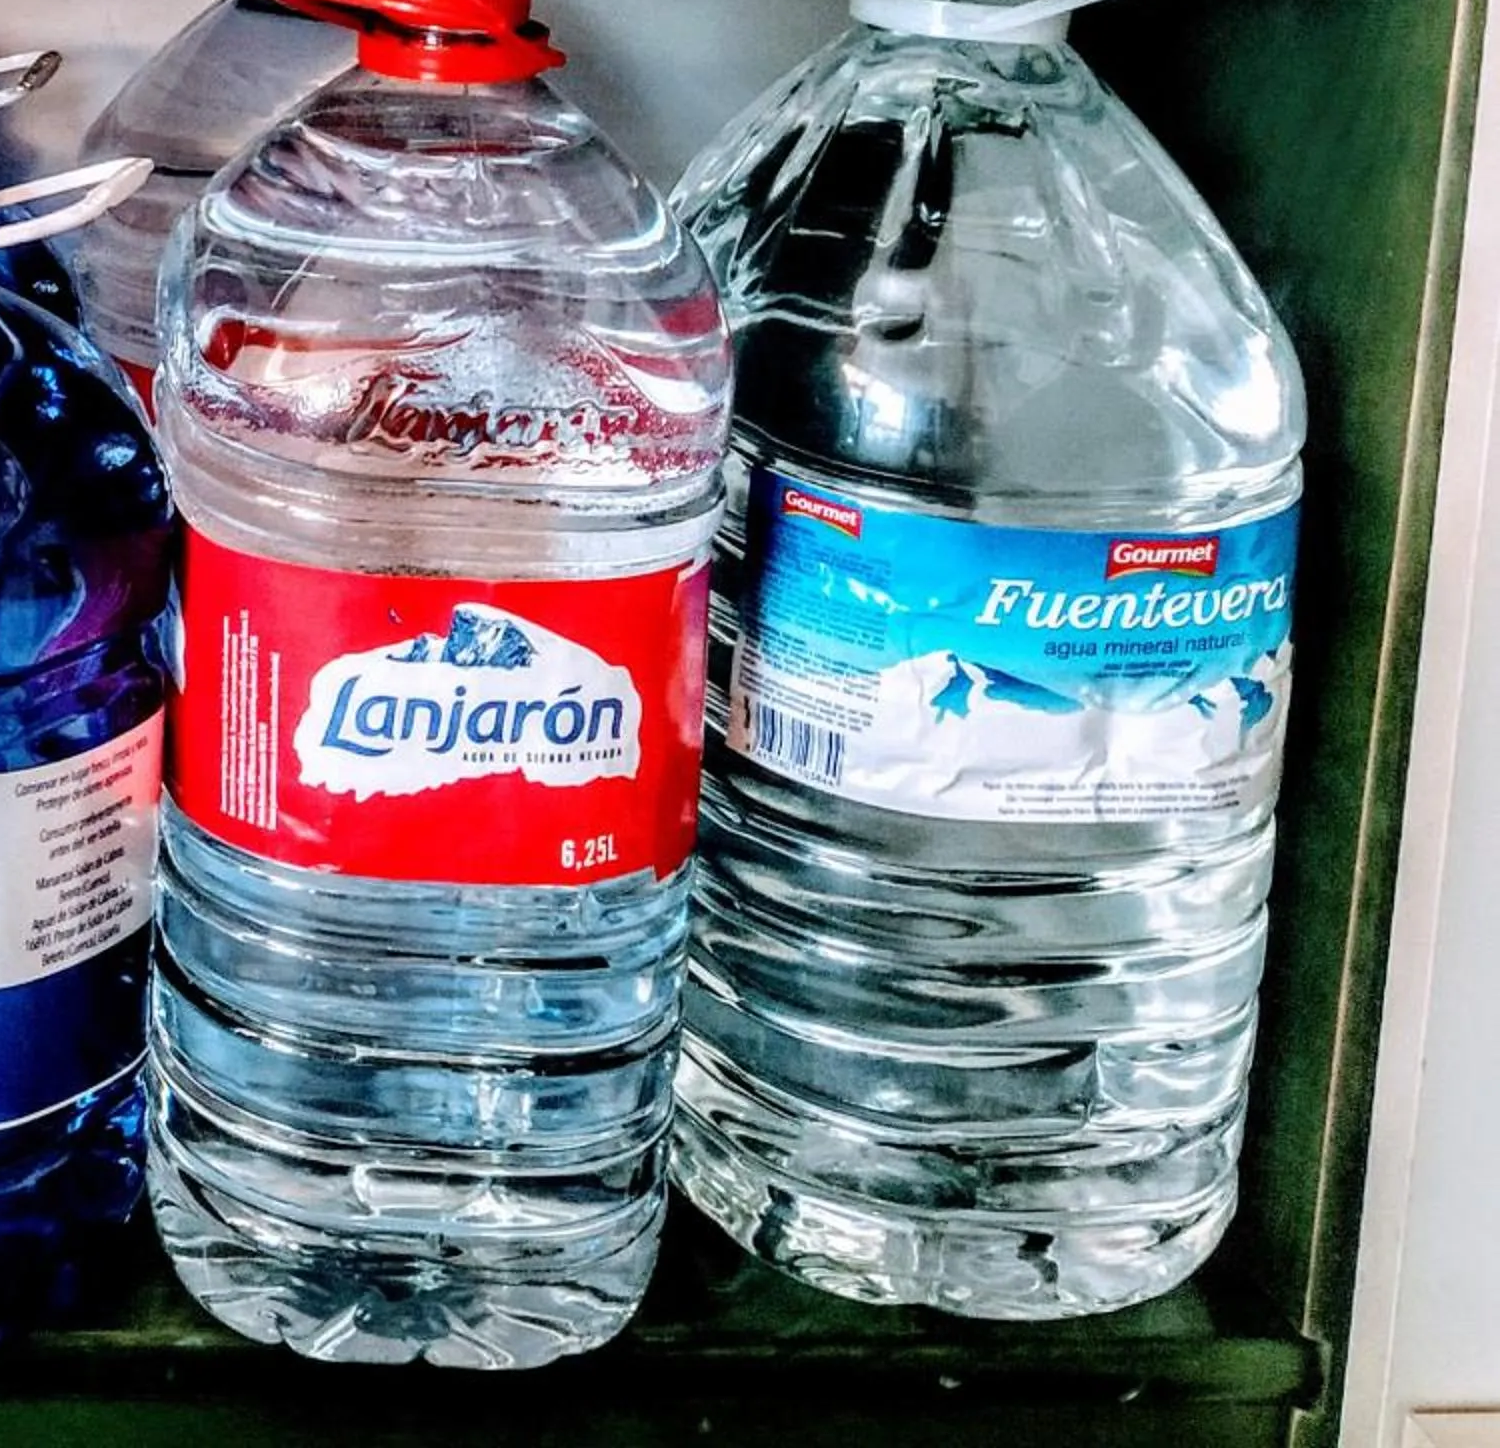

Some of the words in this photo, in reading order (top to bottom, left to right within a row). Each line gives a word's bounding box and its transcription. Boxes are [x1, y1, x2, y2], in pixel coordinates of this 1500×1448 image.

[784, 491, 858, 527] Gourmet
[1112, 541, 1215, 564] Gourmet
[974, 573, 1287, 630] Fuentevera
[1043, 641, 1097, 659] agua
[1103, 637, 1179, 656] mineral
[321, 674, 624, 758] Lanjarón
[463, 752, 495, 764] AGUA
[579, 747, 623, 763] NEVADA
[560, 833, 619, 871] 6,25L
